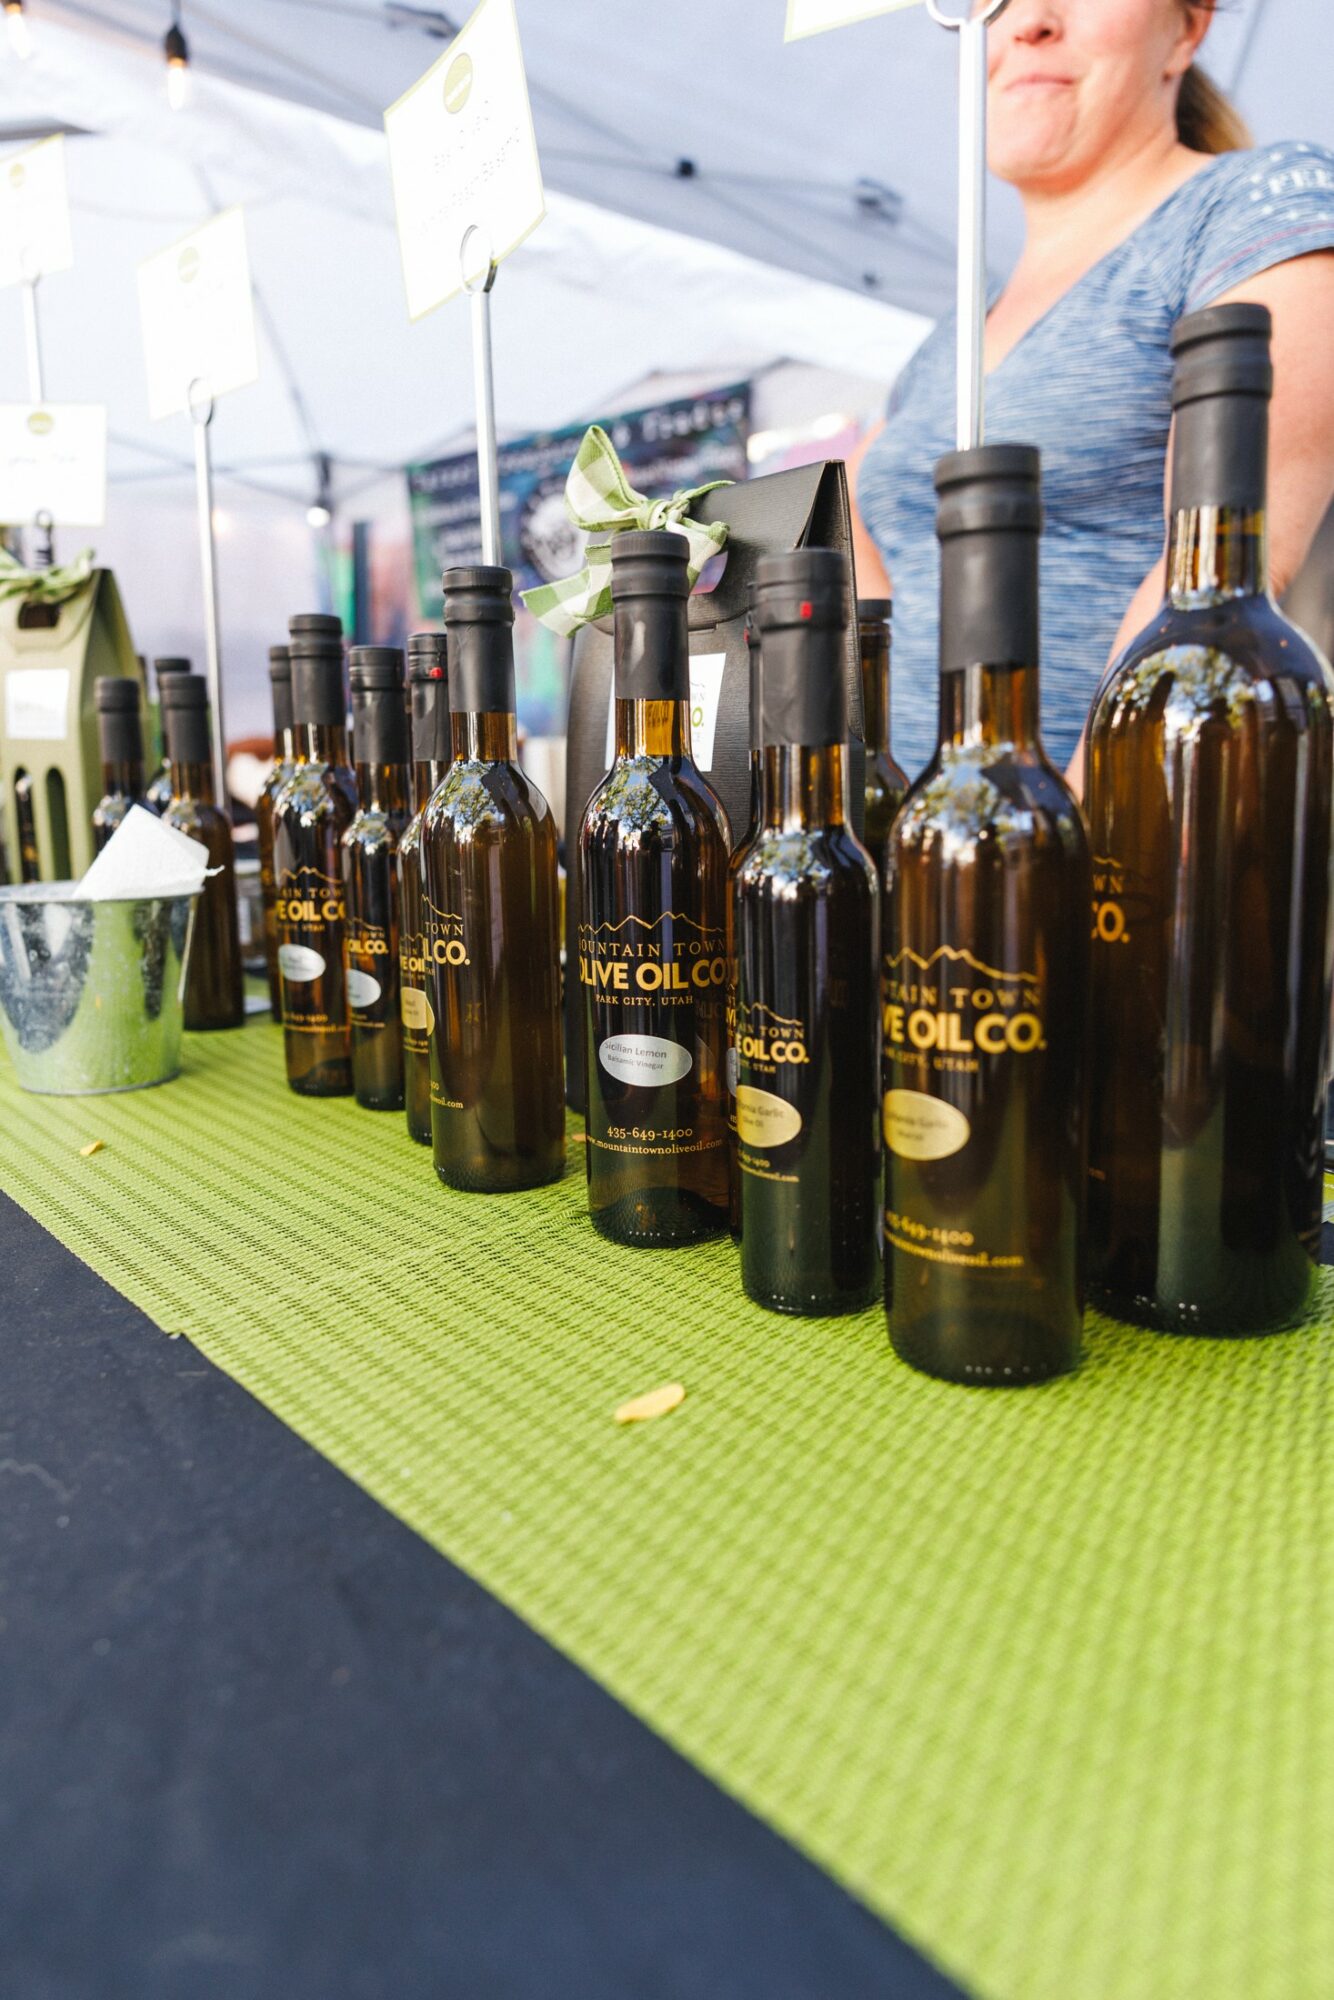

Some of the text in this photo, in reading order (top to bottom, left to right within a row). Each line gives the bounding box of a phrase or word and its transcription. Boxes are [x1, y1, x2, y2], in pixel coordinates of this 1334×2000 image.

[288, 900, 321, 922] OIL
[425, 921, 464, 936] TOWN
[433, 939, 471, 966] CO.
[673, 939, 725, 957] TOWN
[636, 961, 689, 991] OIL
[596, 994, 619, 1006] PARK
[661, 996, 694, 1006] UTAH
[949, 987, 1041, 1010] TOWN
[907, 1008, 974, 1053] OIL
[974, 1011, 1048, 1055] CO.
[605, 1042, 667, 1058] Sicilian Lemon
[743, 1036, 770, 1061] OIL
[770, 1040, 810, 1064] CO.
[636, 1058, 665, 1071] Vinegar
[607, 1125, 693, 1142] 435-649-1400
